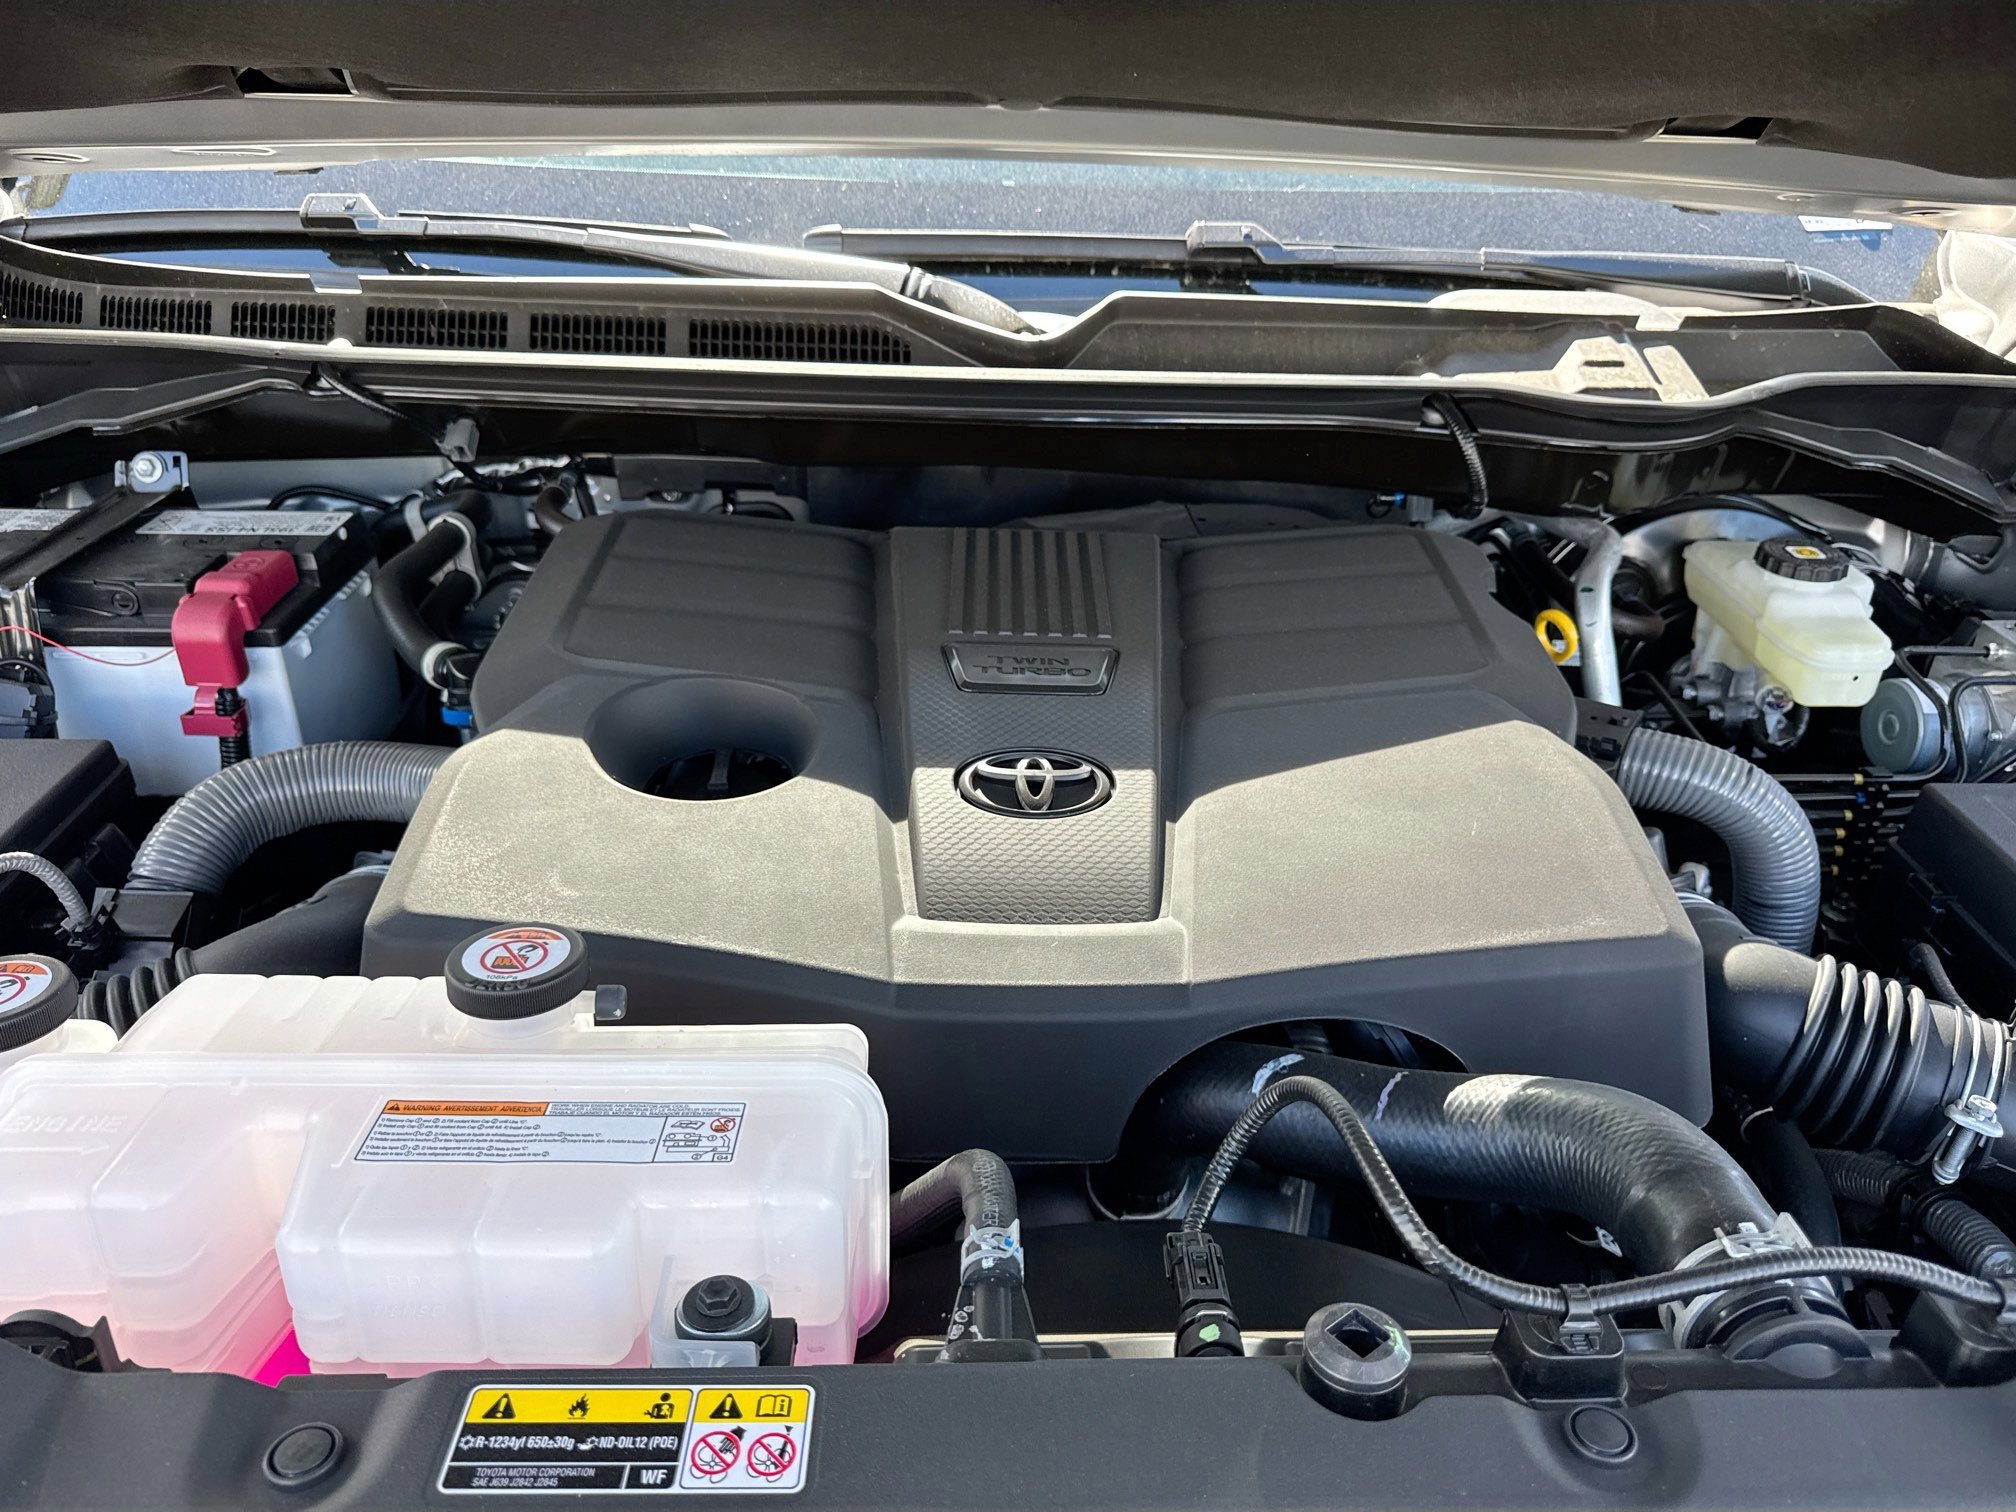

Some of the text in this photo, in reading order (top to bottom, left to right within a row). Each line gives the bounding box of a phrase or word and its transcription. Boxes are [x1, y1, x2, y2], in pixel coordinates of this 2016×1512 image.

[988, 655, 1070, 666] TWIN
[972, 664, 1092, 677] TURBO
[475, 1436, 678, 1451] R-1234yf 650±30g ND-OIL12 (POE)
[476, 1468, 595, 1477] TOYOTA MOTOR CORPORATION
[641, 1469, 667, 1485] WF
[472, 1478, 488, 1487] SAE
[489, 1478, 509, 1487] J639
[510, 1478, 534, 1487] J2842
